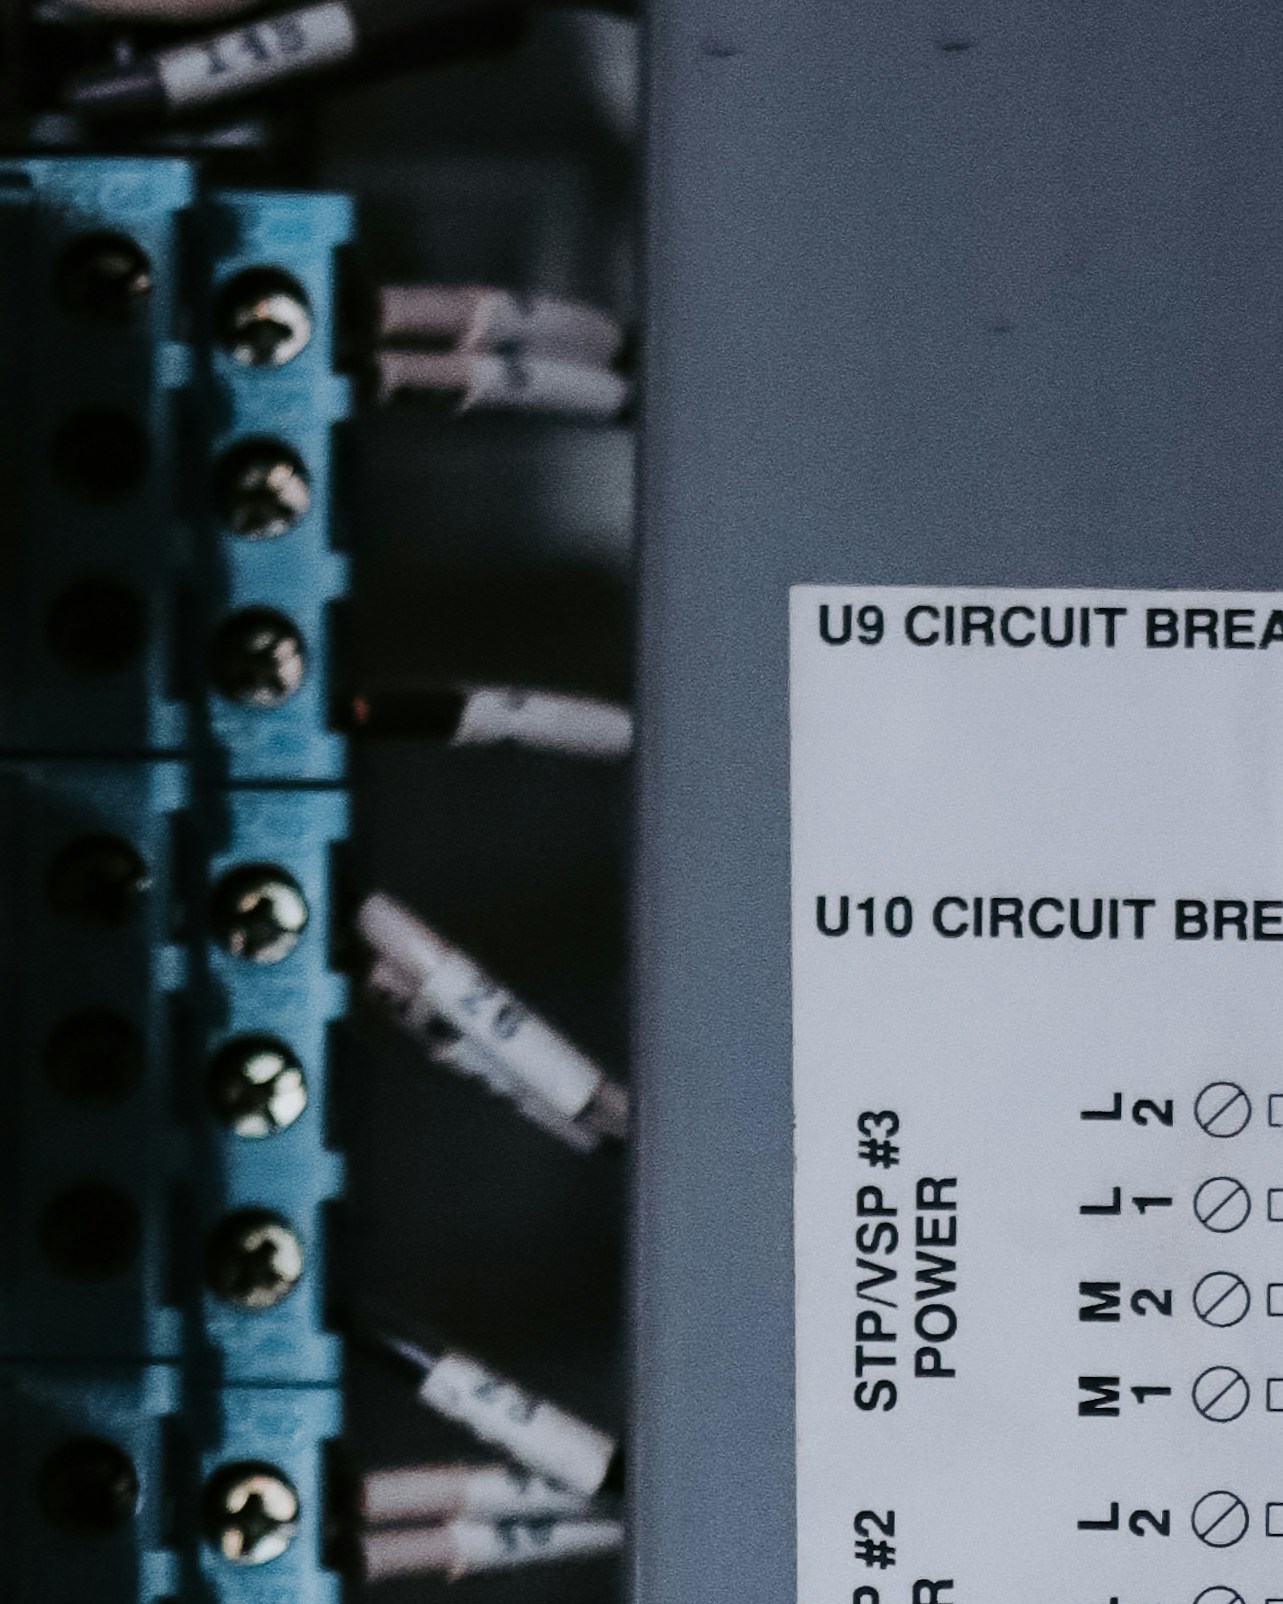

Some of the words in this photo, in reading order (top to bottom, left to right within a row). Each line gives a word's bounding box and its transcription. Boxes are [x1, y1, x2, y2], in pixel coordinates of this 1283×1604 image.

[820, 604, 884, 645] U9
[905, 605, 1127, 647] CIRCUIT
[817, 896, 913, 937] U10
[933, 896, 1155, 939] CIRCUIT
[1081, 1092, 1122, 1120] L
[1132, 1099, 1173, 1126] 2
[858, 1110, 899, 1169] #3
[1080, 1187, 1121, 1215] L
[1132, 1197, 1172, 1214] 1
[915, 1177, 957, 1377] POWER
[854, 1185, 898, 1411] STP/VSP
[1079, 1282, 1120, 1322] M
[1131, 1289, 1172, 1316] 2
[1079, 1376, 1119, 1416] M
[1131, 1386, 1171, 1403] 1
[1078, 1502, 1119, 1530] L
[1129, 1510, 1170, 1536] 2
[854, 1510, 895, 1569] #2
